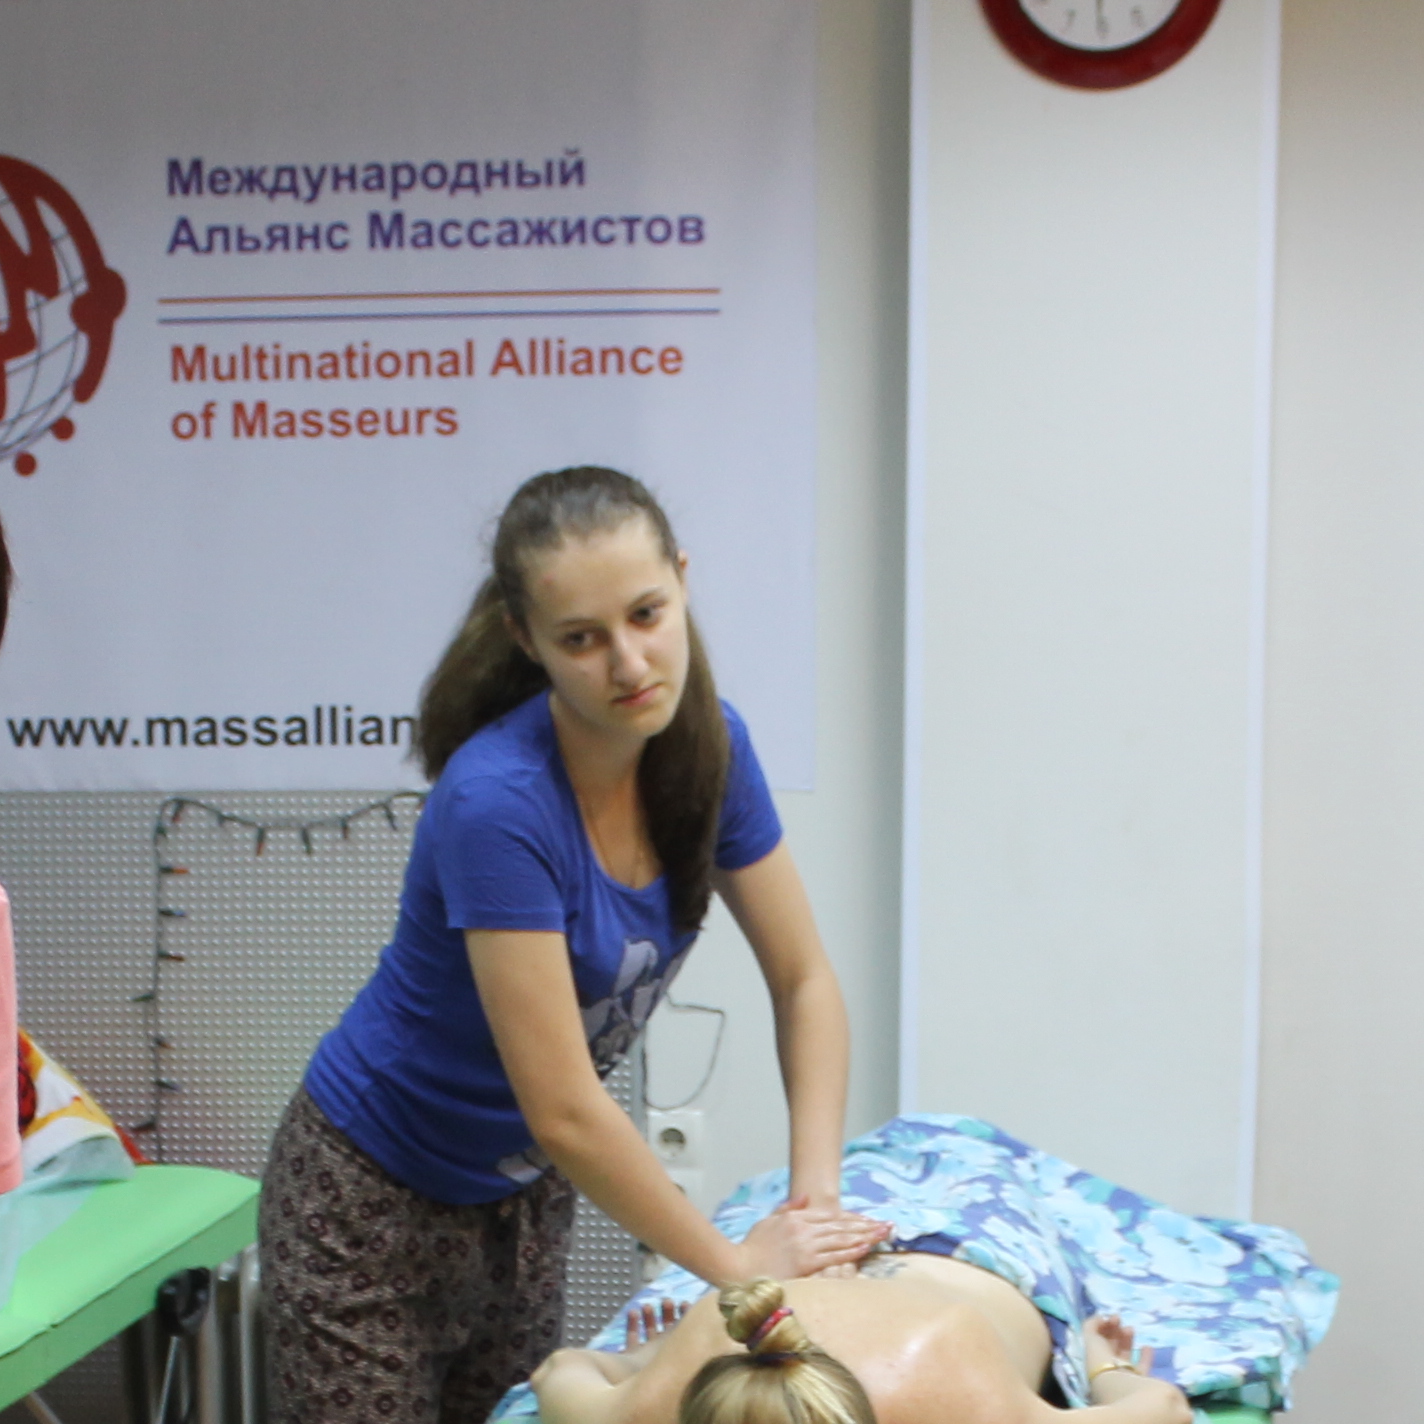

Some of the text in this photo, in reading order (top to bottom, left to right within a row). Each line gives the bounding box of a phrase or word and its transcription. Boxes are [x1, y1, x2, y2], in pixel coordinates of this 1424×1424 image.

[166, 147, 586, 204] Международный
[166, 208, 706, 256] Альянс Массажистов
[170, 338, 684, 383] Multinational Alliance
[170, 400, 460, 441] of Masseurs
